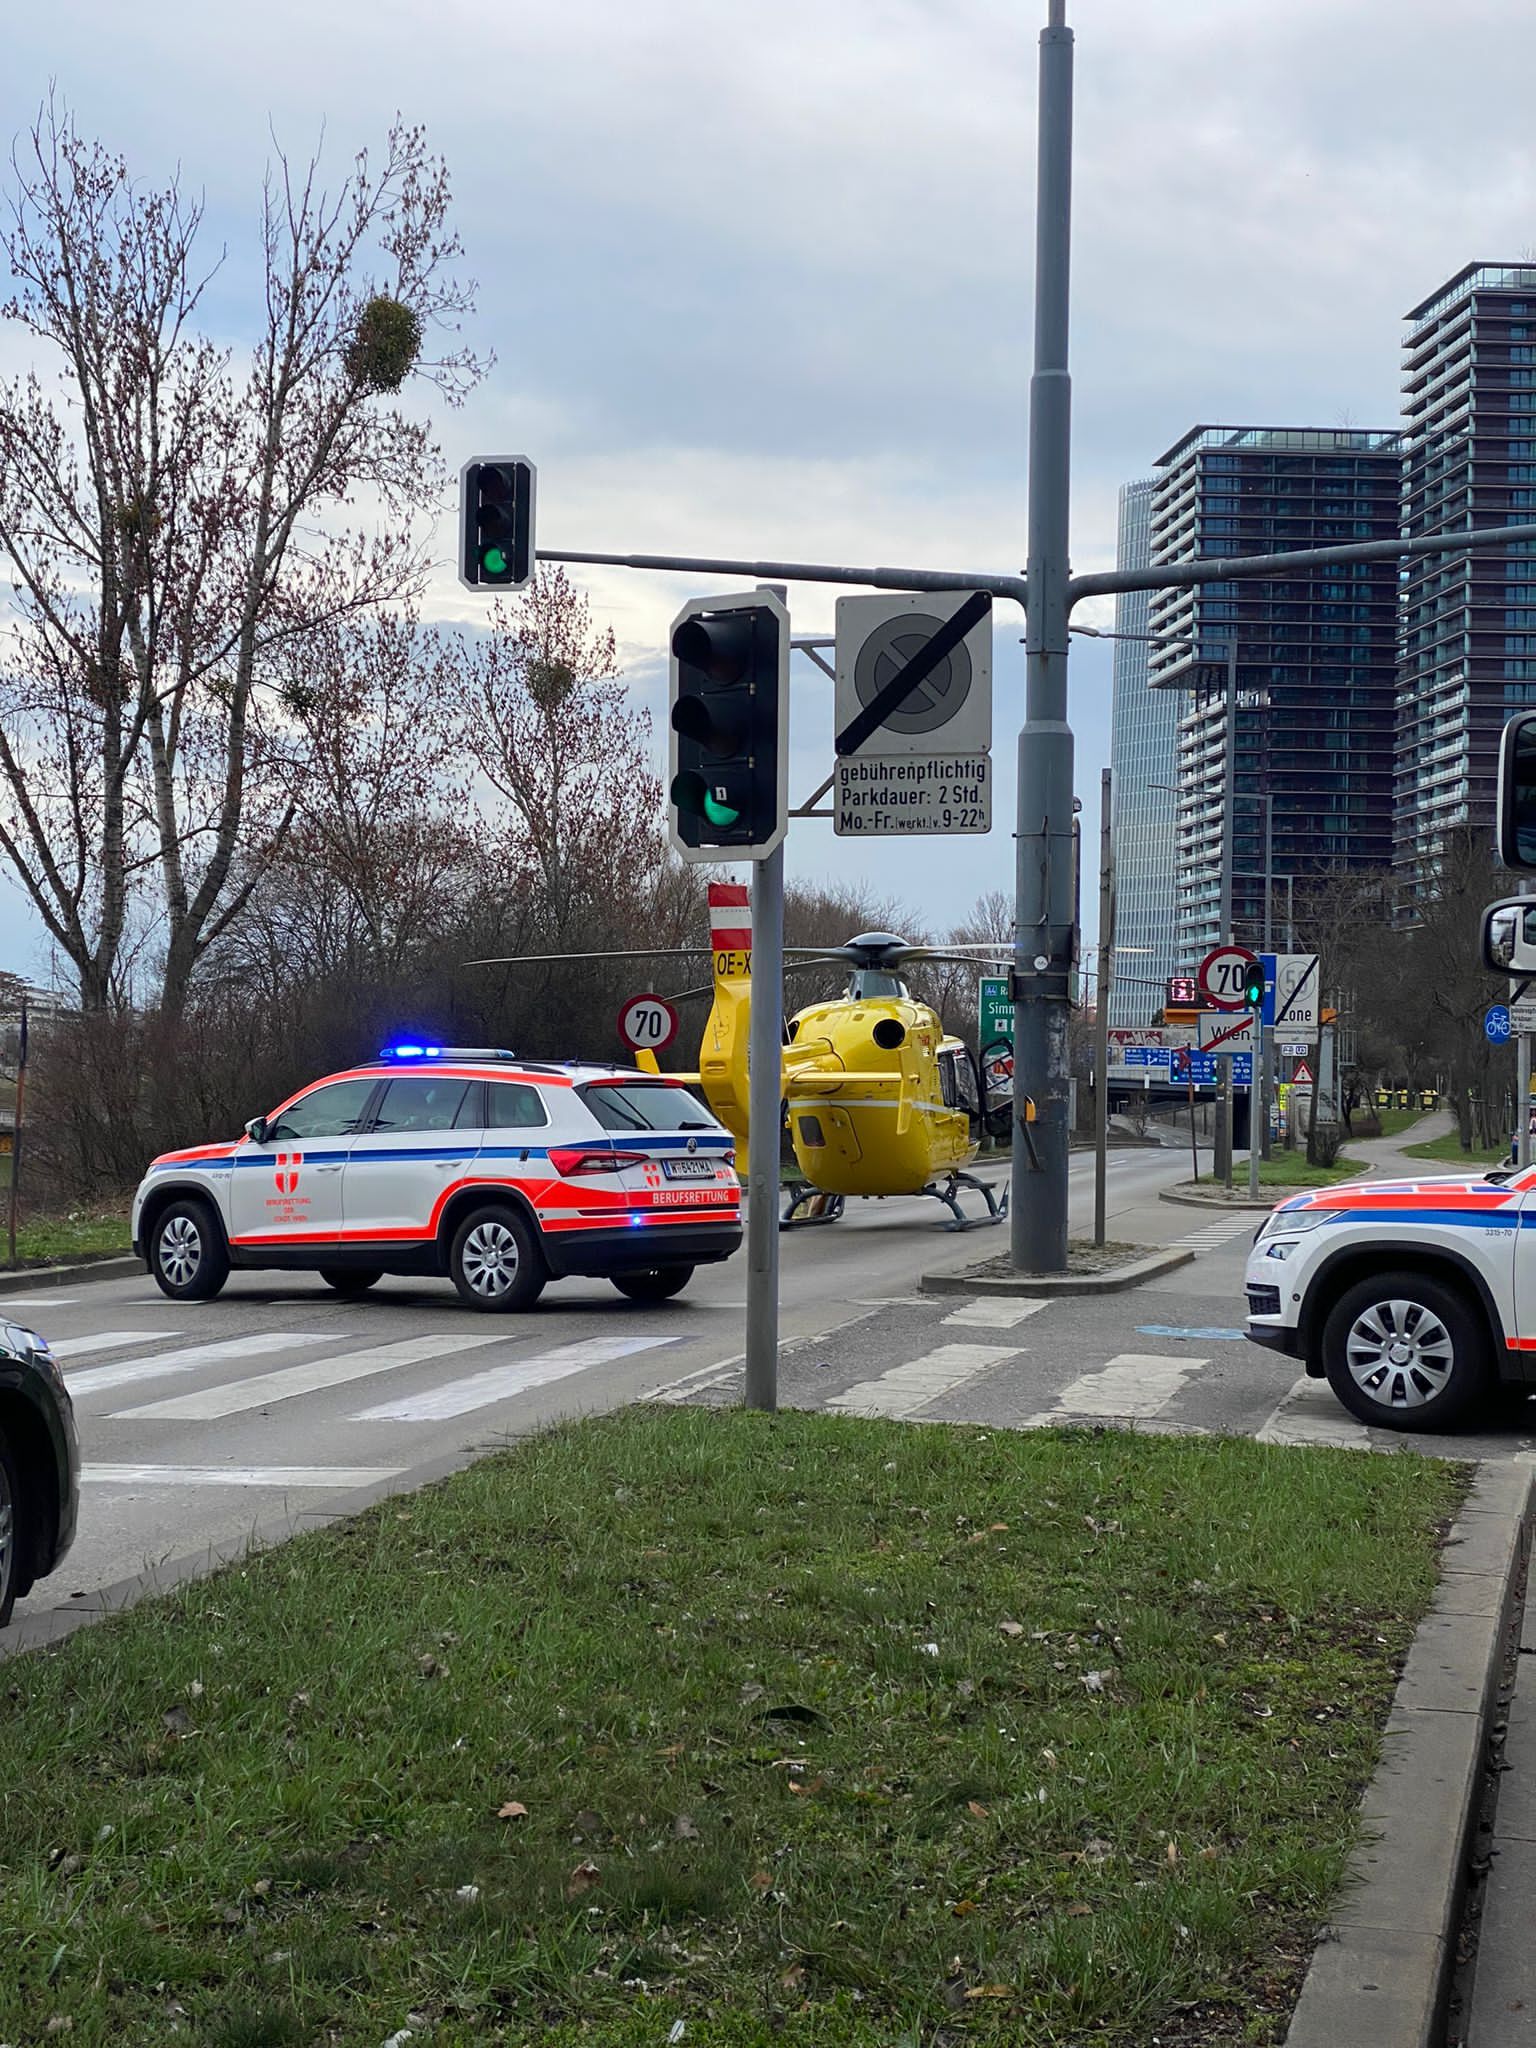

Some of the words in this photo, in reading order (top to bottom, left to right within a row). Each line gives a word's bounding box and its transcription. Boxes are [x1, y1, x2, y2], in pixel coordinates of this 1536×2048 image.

[841, 760, 986, 786] gebührenpflichtig
[842, 787, 931, 806] Parkdauer:
[939, 785, 948, 804] 2
[953, 784, 984, 804] Std.
[840, 810, 895, 830] Mo.-Fr.
[1217, 964, 1245, 993] 70
[635, 1010, 662, 1039] 70
[1211, 1025, 1250, 1041] Wien
[652, 1190, 729, 1204] BERUFSRETTUNG
